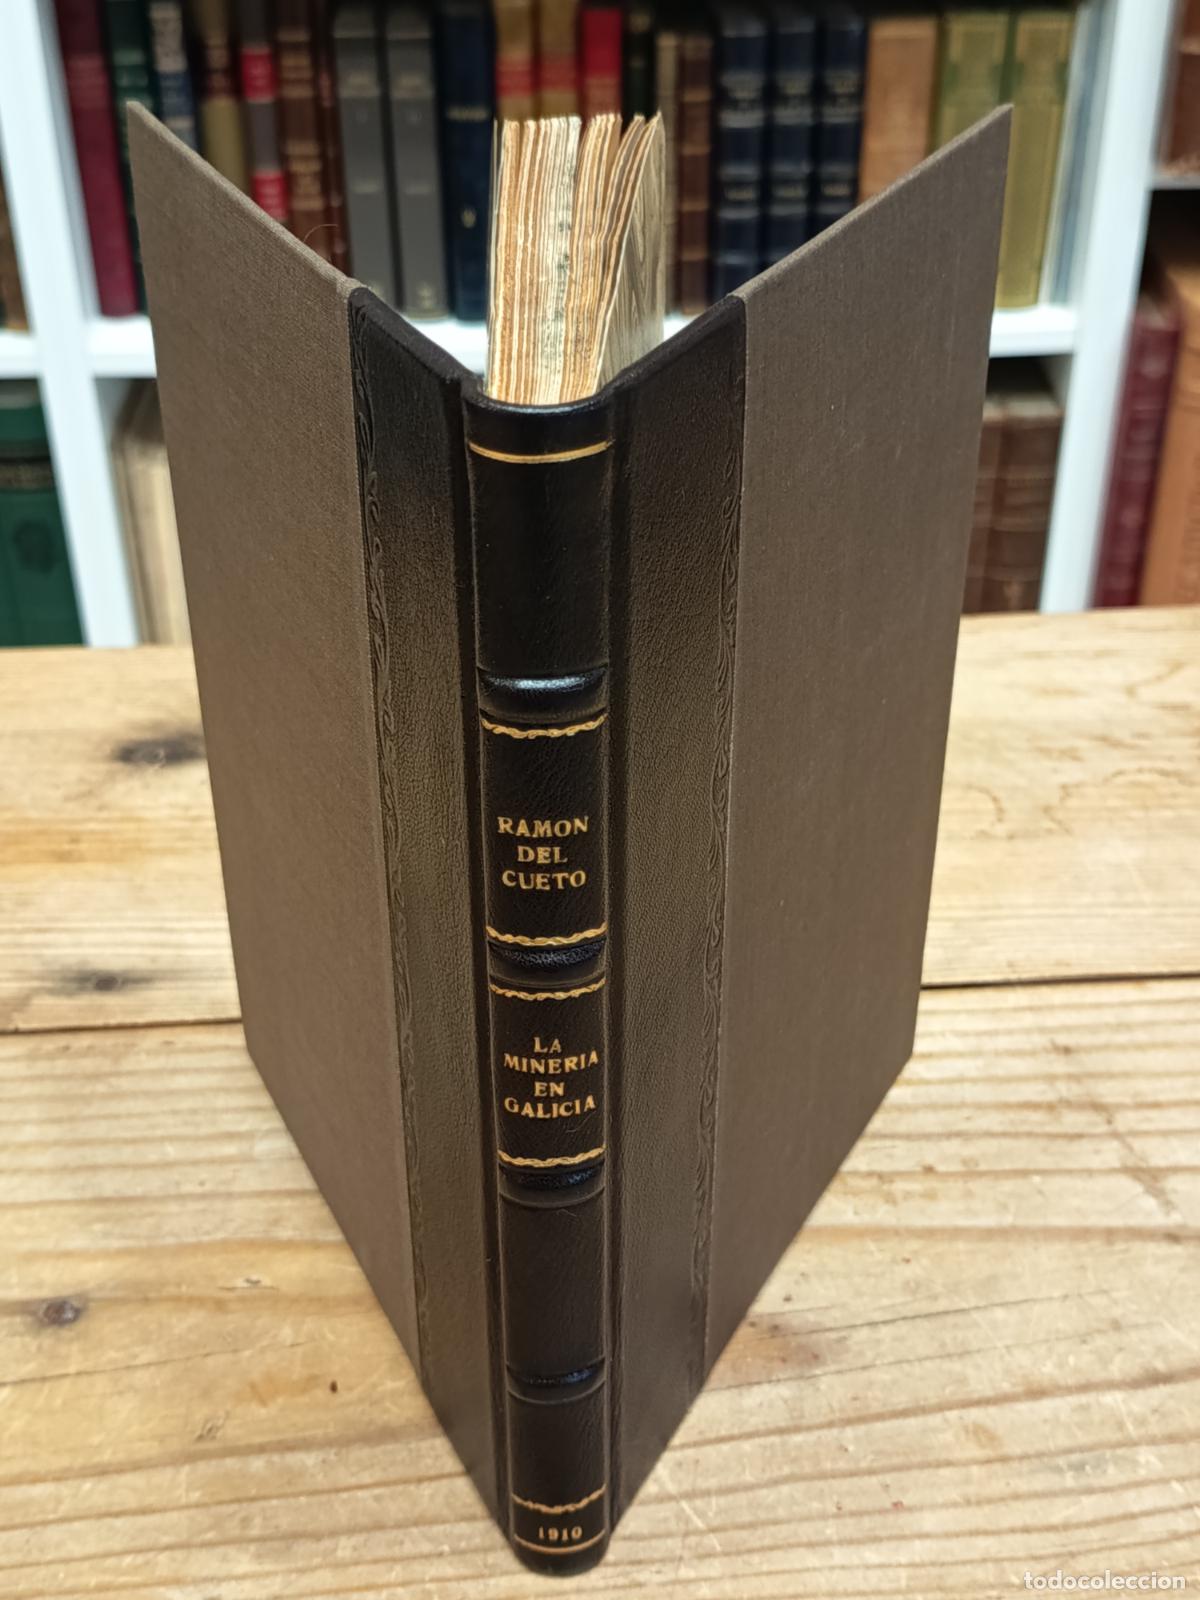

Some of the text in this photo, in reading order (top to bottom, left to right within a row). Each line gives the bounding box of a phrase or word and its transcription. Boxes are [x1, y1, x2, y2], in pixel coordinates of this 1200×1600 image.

[497, 815, 589, 838] RAMON
[517, 845, 568, 864] DEL
[501, 870, 587, 890] CUETO
[534, 1036, 562, 1053] LA
[504, 1050, 599, 1074] MINERIA
[534, 1081, 565, 1097] EN
[504, 1094, 596, 1118] GALICIA
[538, 1526, 583, 1542] 1910
